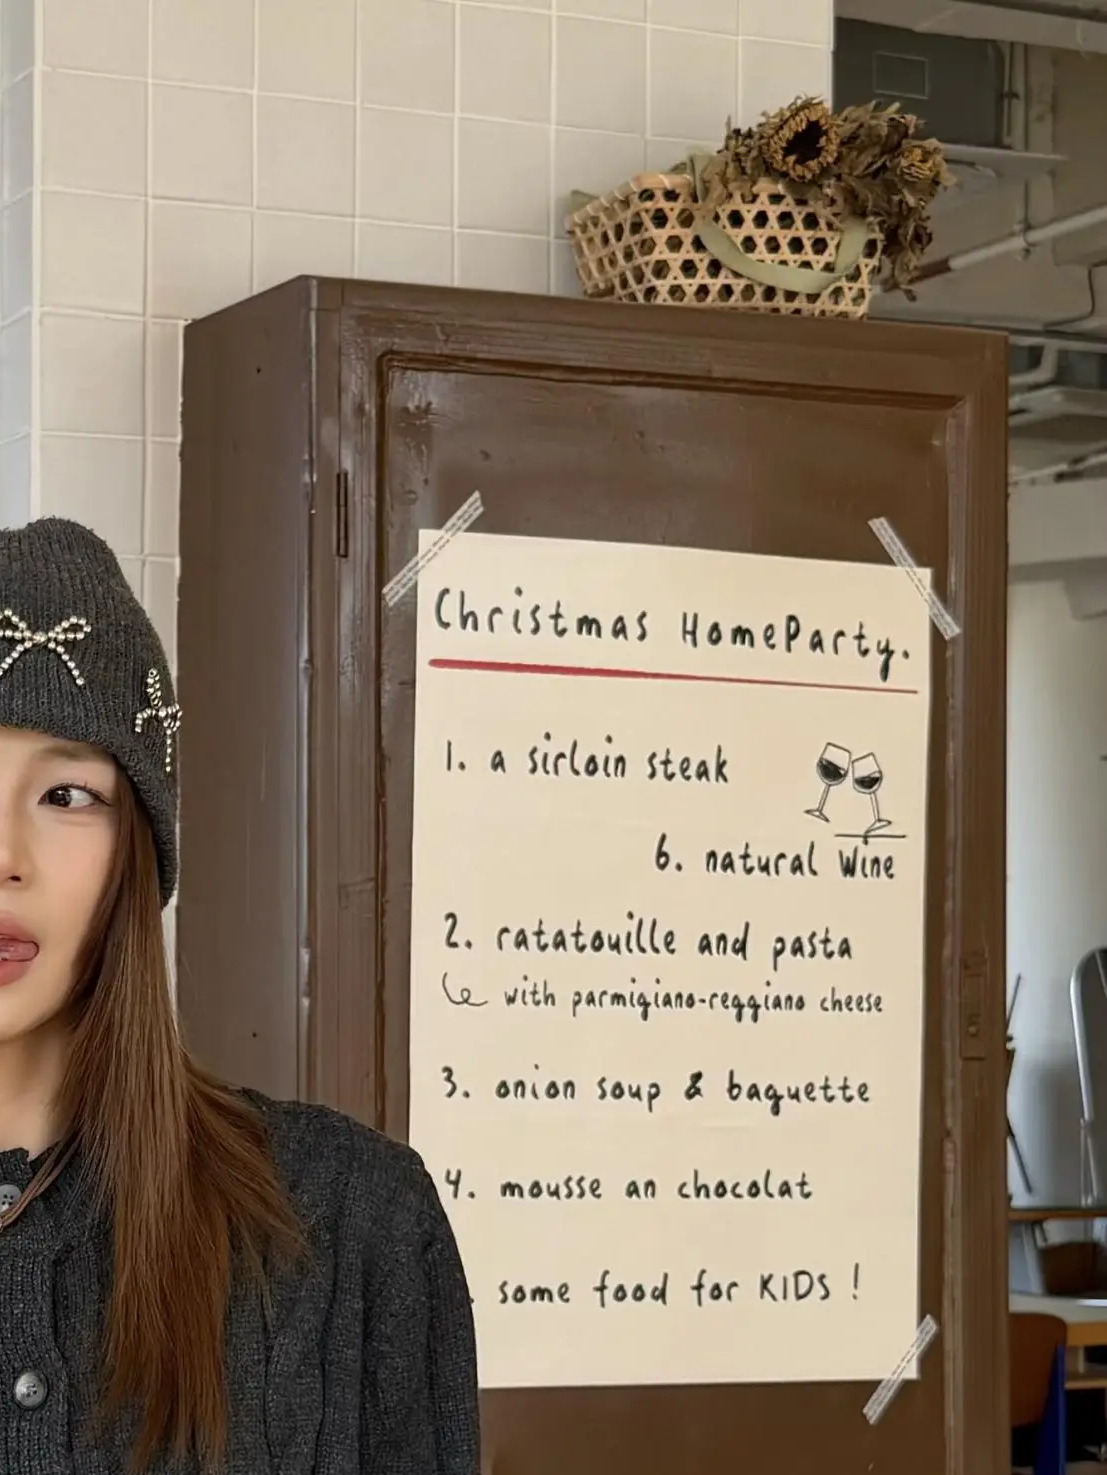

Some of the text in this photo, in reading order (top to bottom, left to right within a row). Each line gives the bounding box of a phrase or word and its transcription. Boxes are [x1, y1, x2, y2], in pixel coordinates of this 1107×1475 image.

[434, 586, 910, 683] Christmas HomeParty.
[446, 731, 729, 784] 1. a sirloin steak
[655, 832, 683, 873] 6.
[705, 840, 819, 877] natural
[444, 910, 853, 973] 2. ratatouille and pasta
[504, 974, 883, 1024] with parmigiano-reggiano cheese
[441, 1063, 870, 1117] 3. onion soup & baguette
[444, 1168, 813, 1201] 4. mousse an chocolat
[498, 1280, 571, 1305] some
[592, 1269, 669, 1309] food
[689, 1268, 739, 1308] for
[759, 1269, 831, 1302] KIDS
